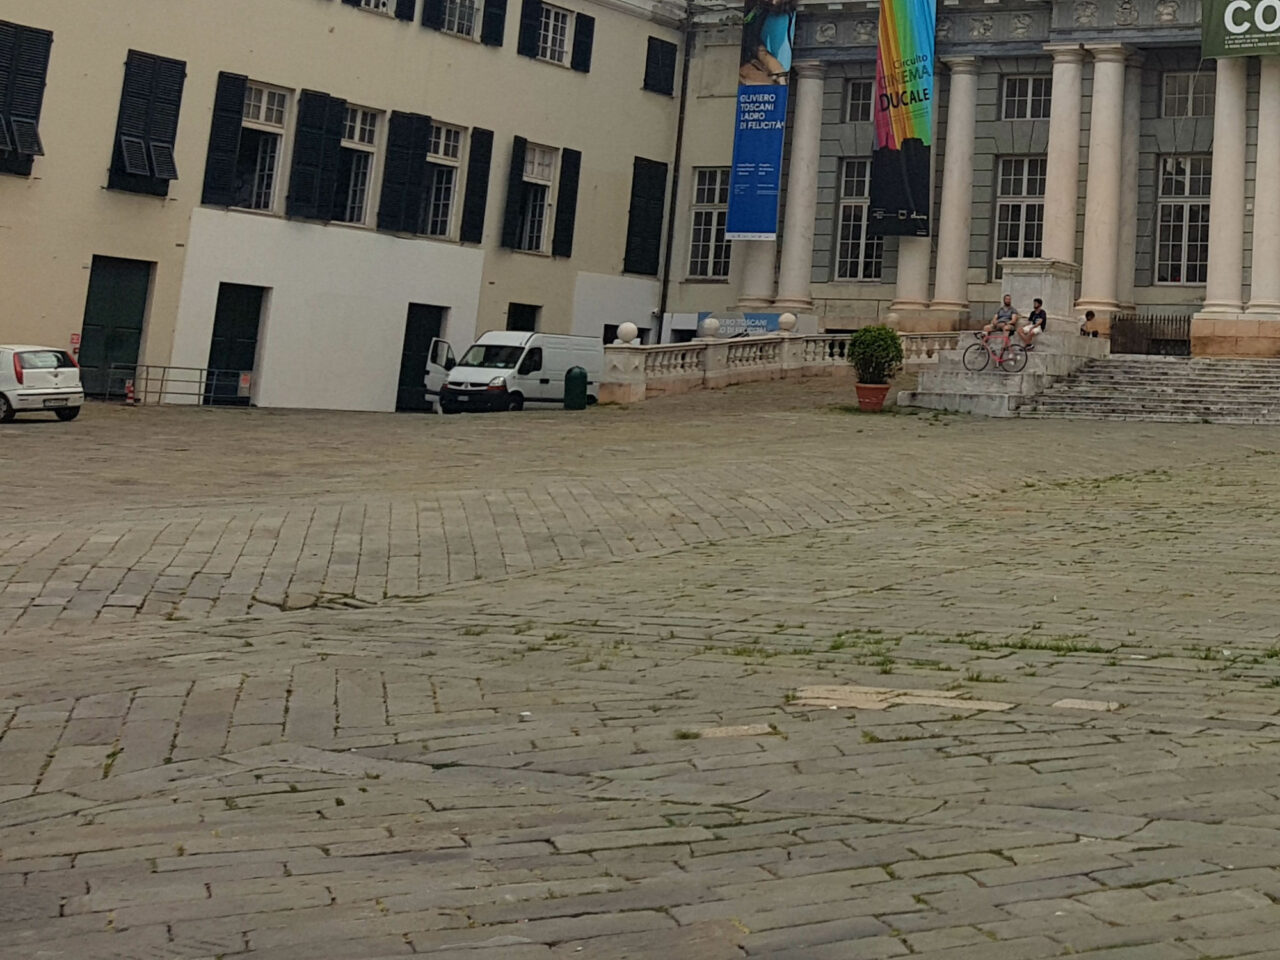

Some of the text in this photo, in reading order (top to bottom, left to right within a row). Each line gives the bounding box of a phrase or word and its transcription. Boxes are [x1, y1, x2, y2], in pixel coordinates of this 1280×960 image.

[894, 54, 928, 70] Circuito
[878, 64, 932, 89] CINEMA
[740, 94, 776, 102] OLIVIERO
[879, 88, 930, 112] DUCALE
[740, 103, 774, 111] TOSCANI
[740, 112, 766, 120] LADRO
